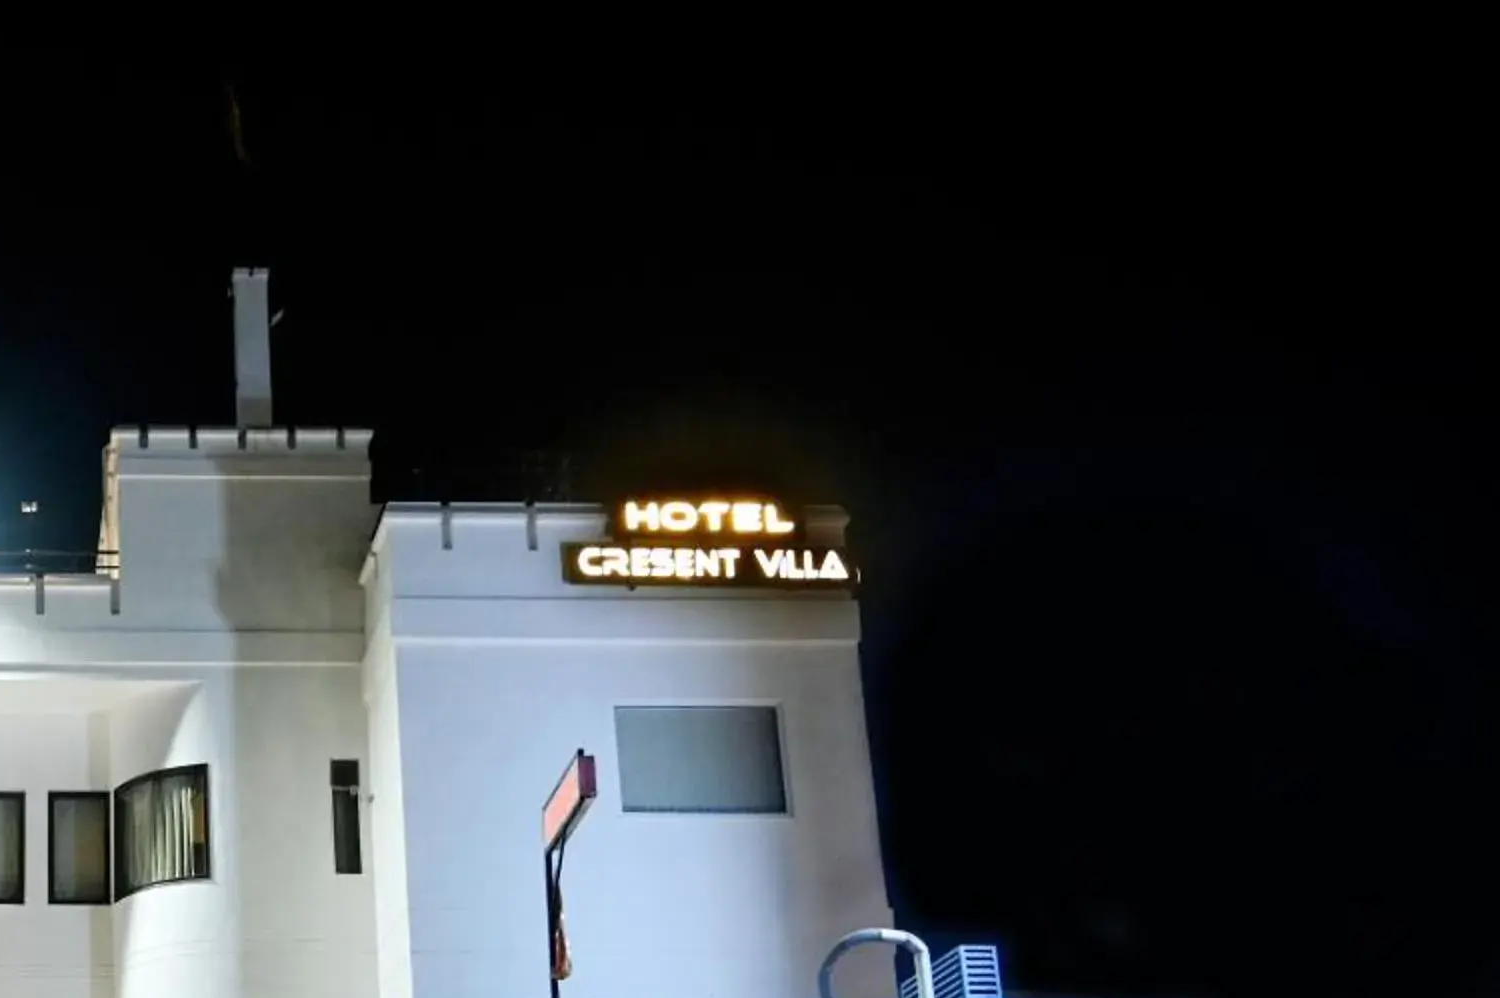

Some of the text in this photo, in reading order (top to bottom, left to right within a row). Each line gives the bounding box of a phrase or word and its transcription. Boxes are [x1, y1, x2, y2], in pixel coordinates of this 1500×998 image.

[624, 501, 796, 534] HOTEL
[577, 547, 850, 580] CRESENT VILLA
